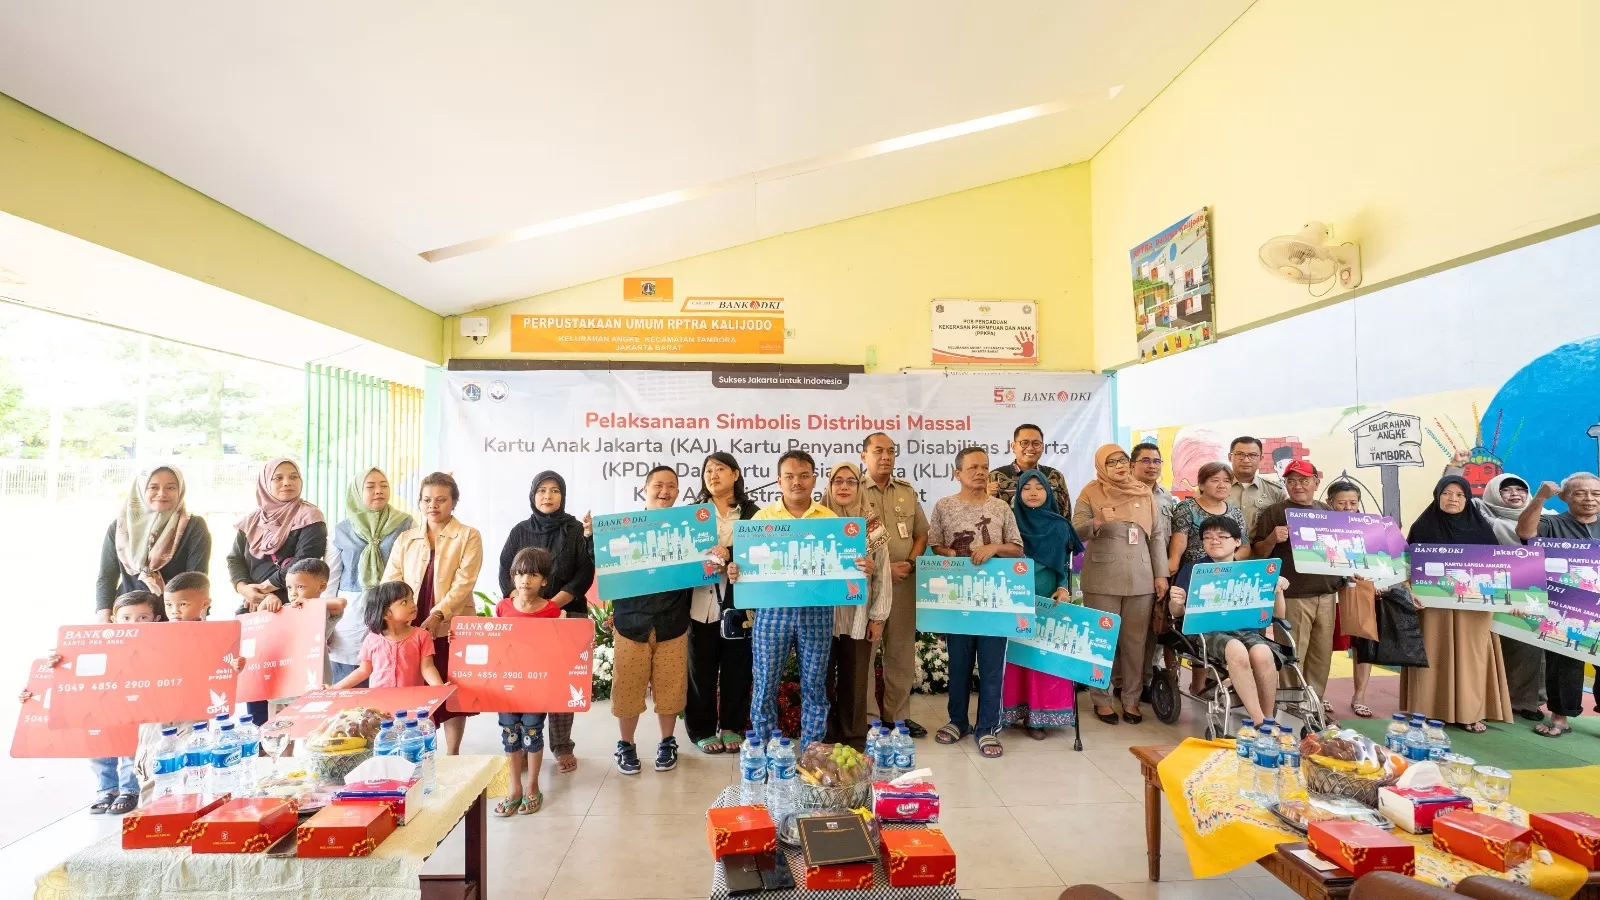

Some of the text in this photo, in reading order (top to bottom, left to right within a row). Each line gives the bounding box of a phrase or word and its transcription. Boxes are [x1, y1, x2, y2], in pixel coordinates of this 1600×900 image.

[719, 301, 781, 309] BANK DKI
[523, 317, 773, 331] PERPUSTAKAAN UMUM RPTRA KALIJODO
[719, 375, 747, 384] Sukses
[748, 376, 779, 384] Jakarta
[803, 377, 843, 385] Indonesia
[1023, 391, 1093, 402] BANK DKI
[585, 412, 971, 431] Pelaksanaan Simbolis Distribusi Massal
[1368, 419, 1411, 433] KELURAHAN
[484, 436, 535, 453] Kartu
[541, 437, 591, 453] Anak
[595, 437, 663, 453] Jakarta
[730, 438, 781, 454] Kartu
[1004, 440, 1070, 454] Jrta
[1369, 449, 1413, 461] TAMBORA
[676, 462, 701, 478] Da
[743, 464, 770, 478] rtu
[913, 463, 955, 481] (KLJ)
[1289, 511, 1328, 520] BANK DKI
[598, 518, 622, 528] BANK
[632, 515, 648, 523] DKI
[738, 524, 791, 533] BANK DKI
[1533, 541, 1562, 549] BANK
[702, 573, 718, 581] GPN
[1546, 584, 1566, 594] DKI
[845, 593, 863, 601] GPN
[1560, 603, 1582, 614] LANSIA
[456, 622, 513, 631] BANK DKI
[1015, 626, 1032, 634] GPN
[64, 628, 140, 640] BANK DKI
[452, 670, 548, 679] 5049 4856 2900 0017
[57, 678, 182, 692] 5049 4856 2900 0017
[1089, 675, 1105, 685] GPN
[206, 704, 229, 714] GPN
[567, 700, 587, 708] GPN
